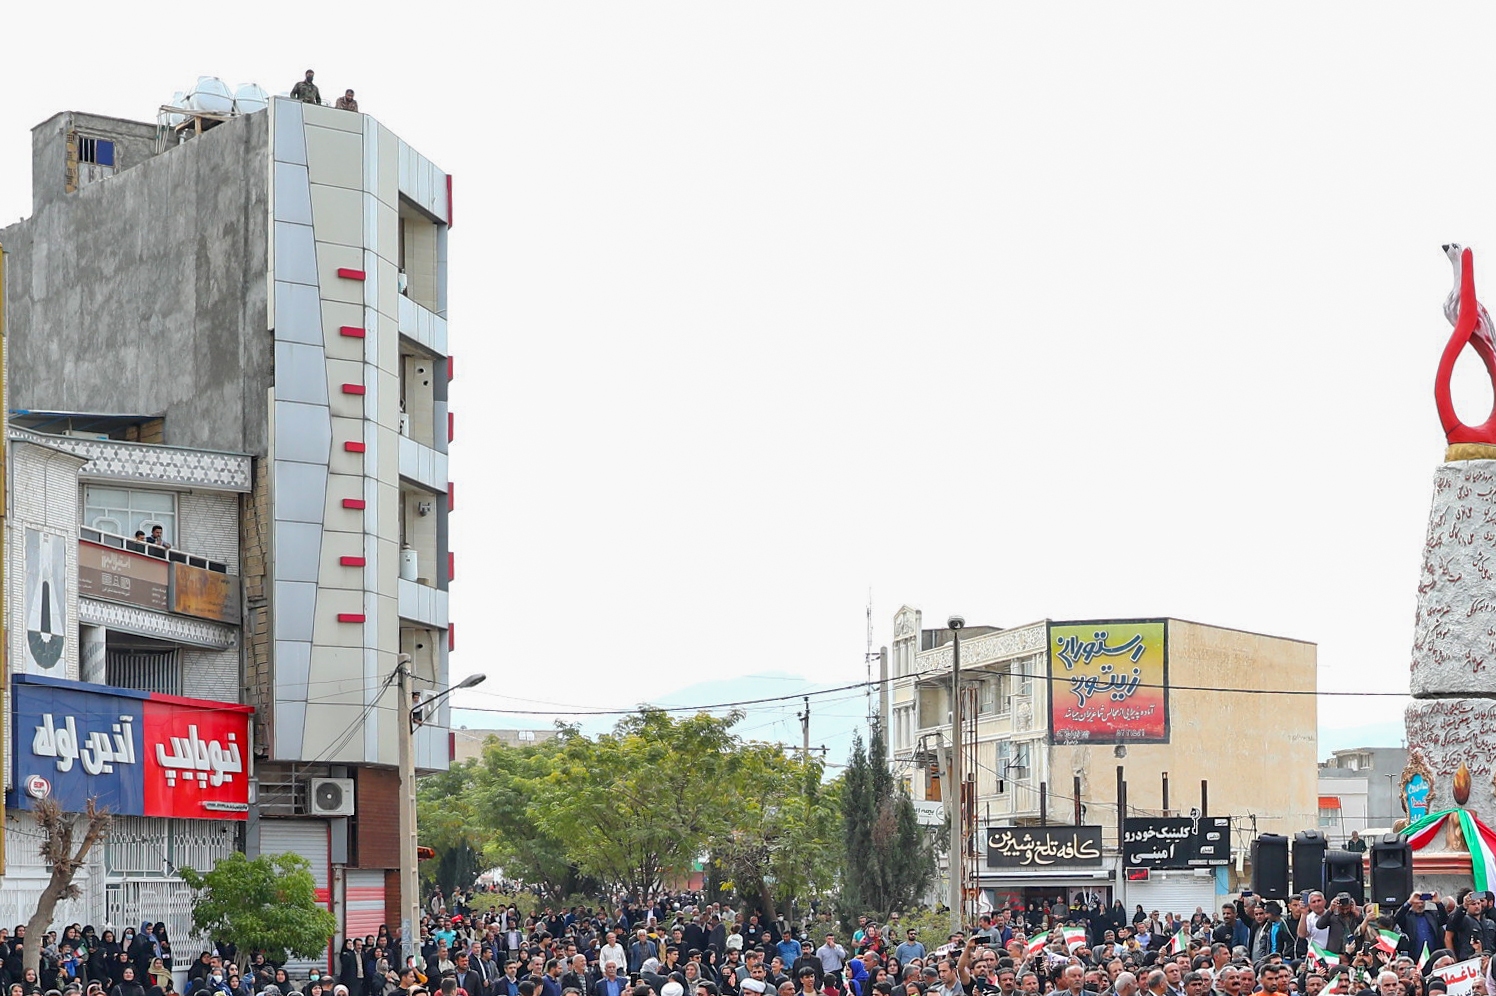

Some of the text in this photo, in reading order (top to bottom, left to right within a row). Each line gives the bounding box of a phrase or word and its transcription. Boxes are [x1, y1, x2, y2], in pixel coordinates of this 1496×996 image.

[1057, 631, 1146, 670] رستوران
[1070, 665, 1141, 708] زیتون
[33, 713, 136, 776] آذین لوله
[988, 830, 1100, 865] کافه تلخ و شیرین
[1123, 826, 1156, 842] خودرو
[1156, 826, 1191, 842] کلینیک
[1130, 843, 1175, 863] امینی
